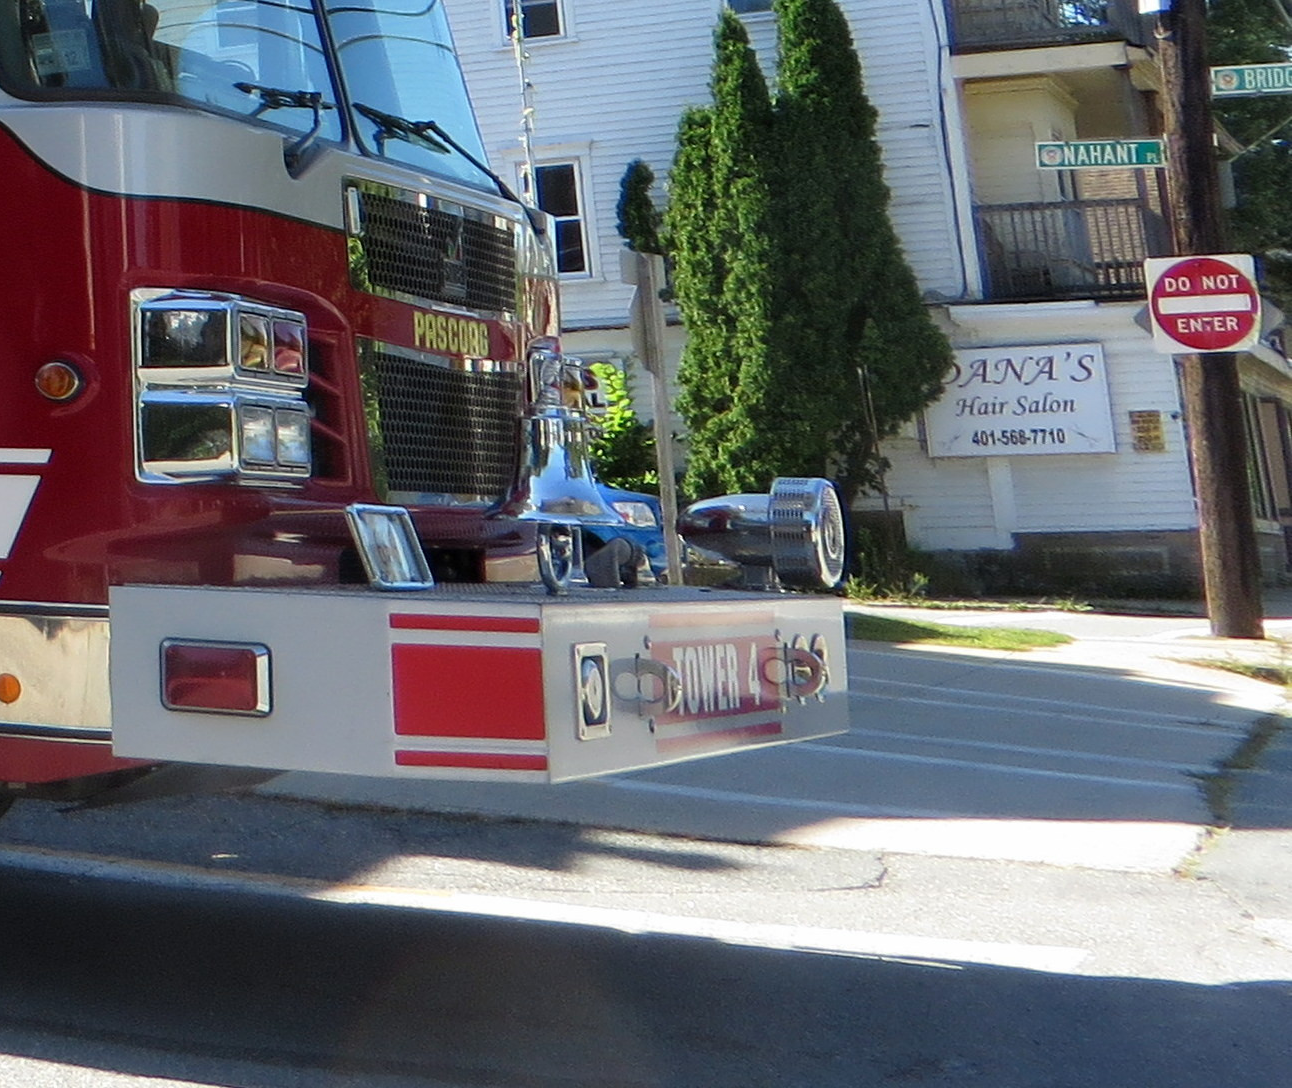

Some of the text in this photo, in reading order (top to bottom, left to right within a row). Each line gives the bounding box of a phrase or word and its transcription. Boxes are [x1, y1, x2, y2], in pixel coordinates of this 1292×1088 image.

[1065, 144, 1138, 165] NAHANT
[1164, 274, 1239, 292] DO NOT
[414, 312, 490, 358] PASCOAG
[1177, 316, 1239, 333] ENTER
[956, 392, 1077, 417] Hair Salon
[972, 428, 1066, 446] 401-568-7710
[673, 642, 761, 716] TOWER 4
